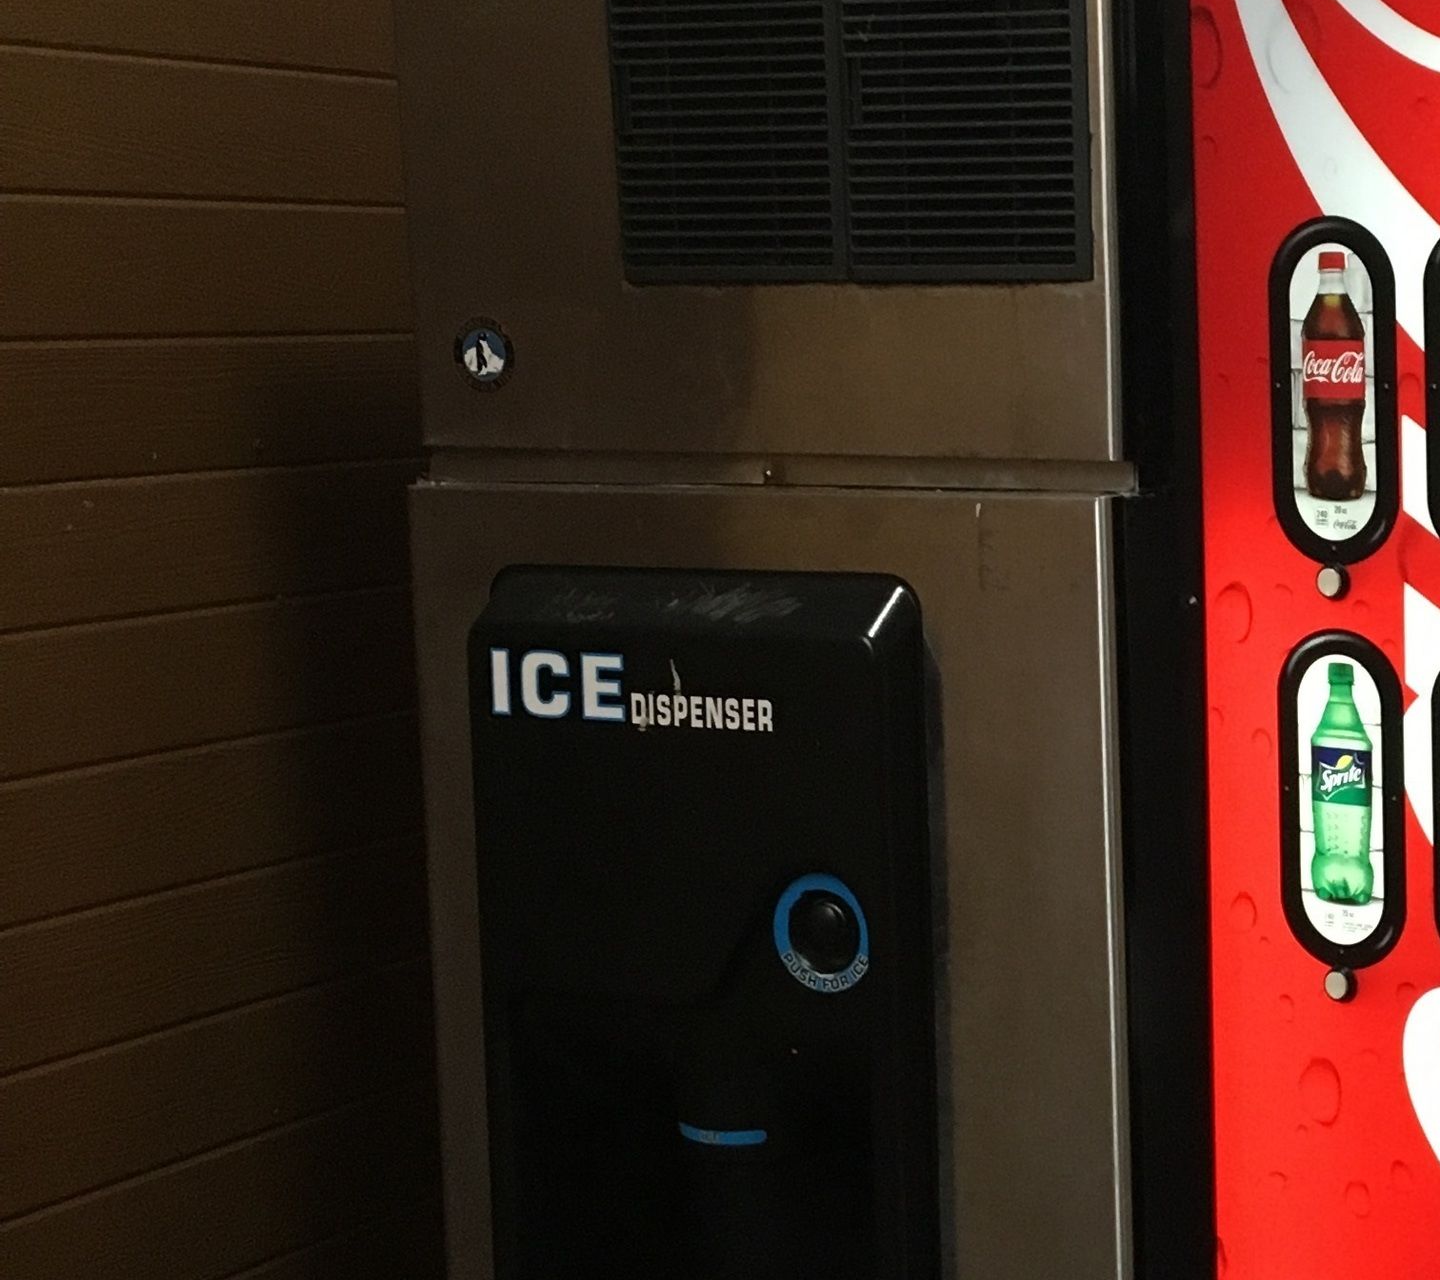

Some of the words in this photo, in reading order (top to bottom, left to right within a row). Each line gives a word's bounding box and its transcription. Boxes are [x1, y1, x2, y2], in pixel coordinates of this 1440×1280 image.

[1303, 350, 1365, 384] Coca-Cola
[490, 647, 626, 722] ICE
[630, 692, 773, 732] DISPENSER
[1320, 764, 1362, 793] Sprite
[783, 953, 817, 987] PUSH
[822, 975, 850, 990] FOR
[851, 954, 868, 979] ICE
